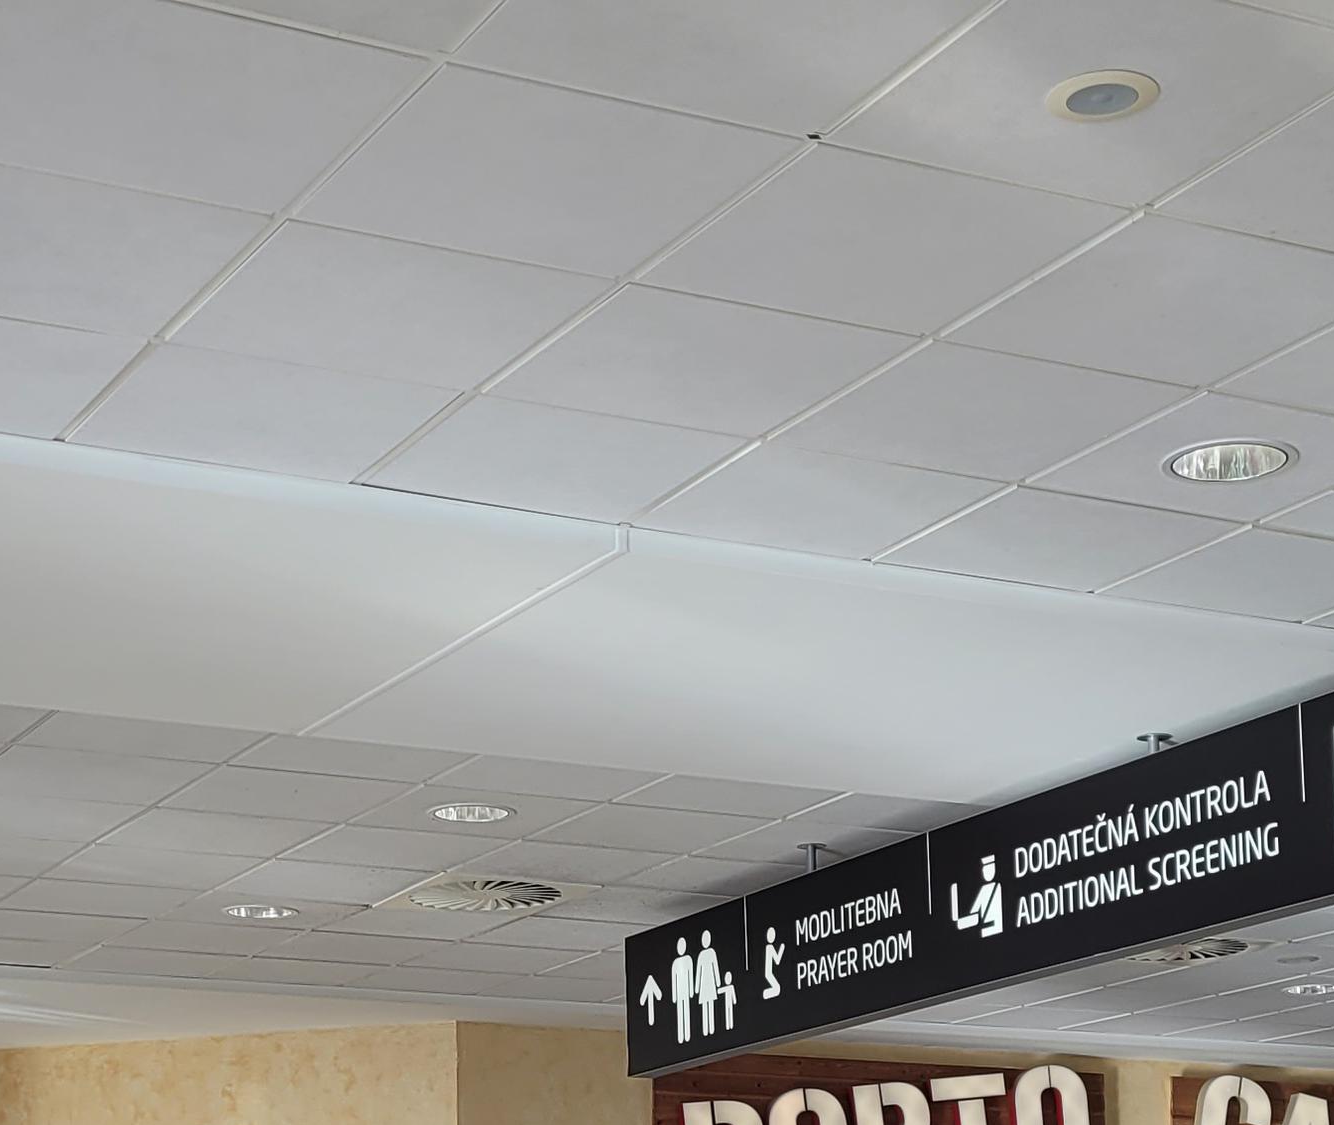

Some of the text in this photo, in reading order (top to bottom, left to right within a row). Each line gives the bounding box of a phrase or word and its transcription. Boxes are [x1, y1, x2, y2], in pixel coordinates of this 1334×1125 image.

[1014, 770, 1271, 878] DODATEČNÁ KONTROLA
[795, 887, 902, 946] MODLITEBNA
[1017, 822, 1280, 928] ADDITIONAL SCREENING
[796, 930, 913, 990] PRAYER ROOM
